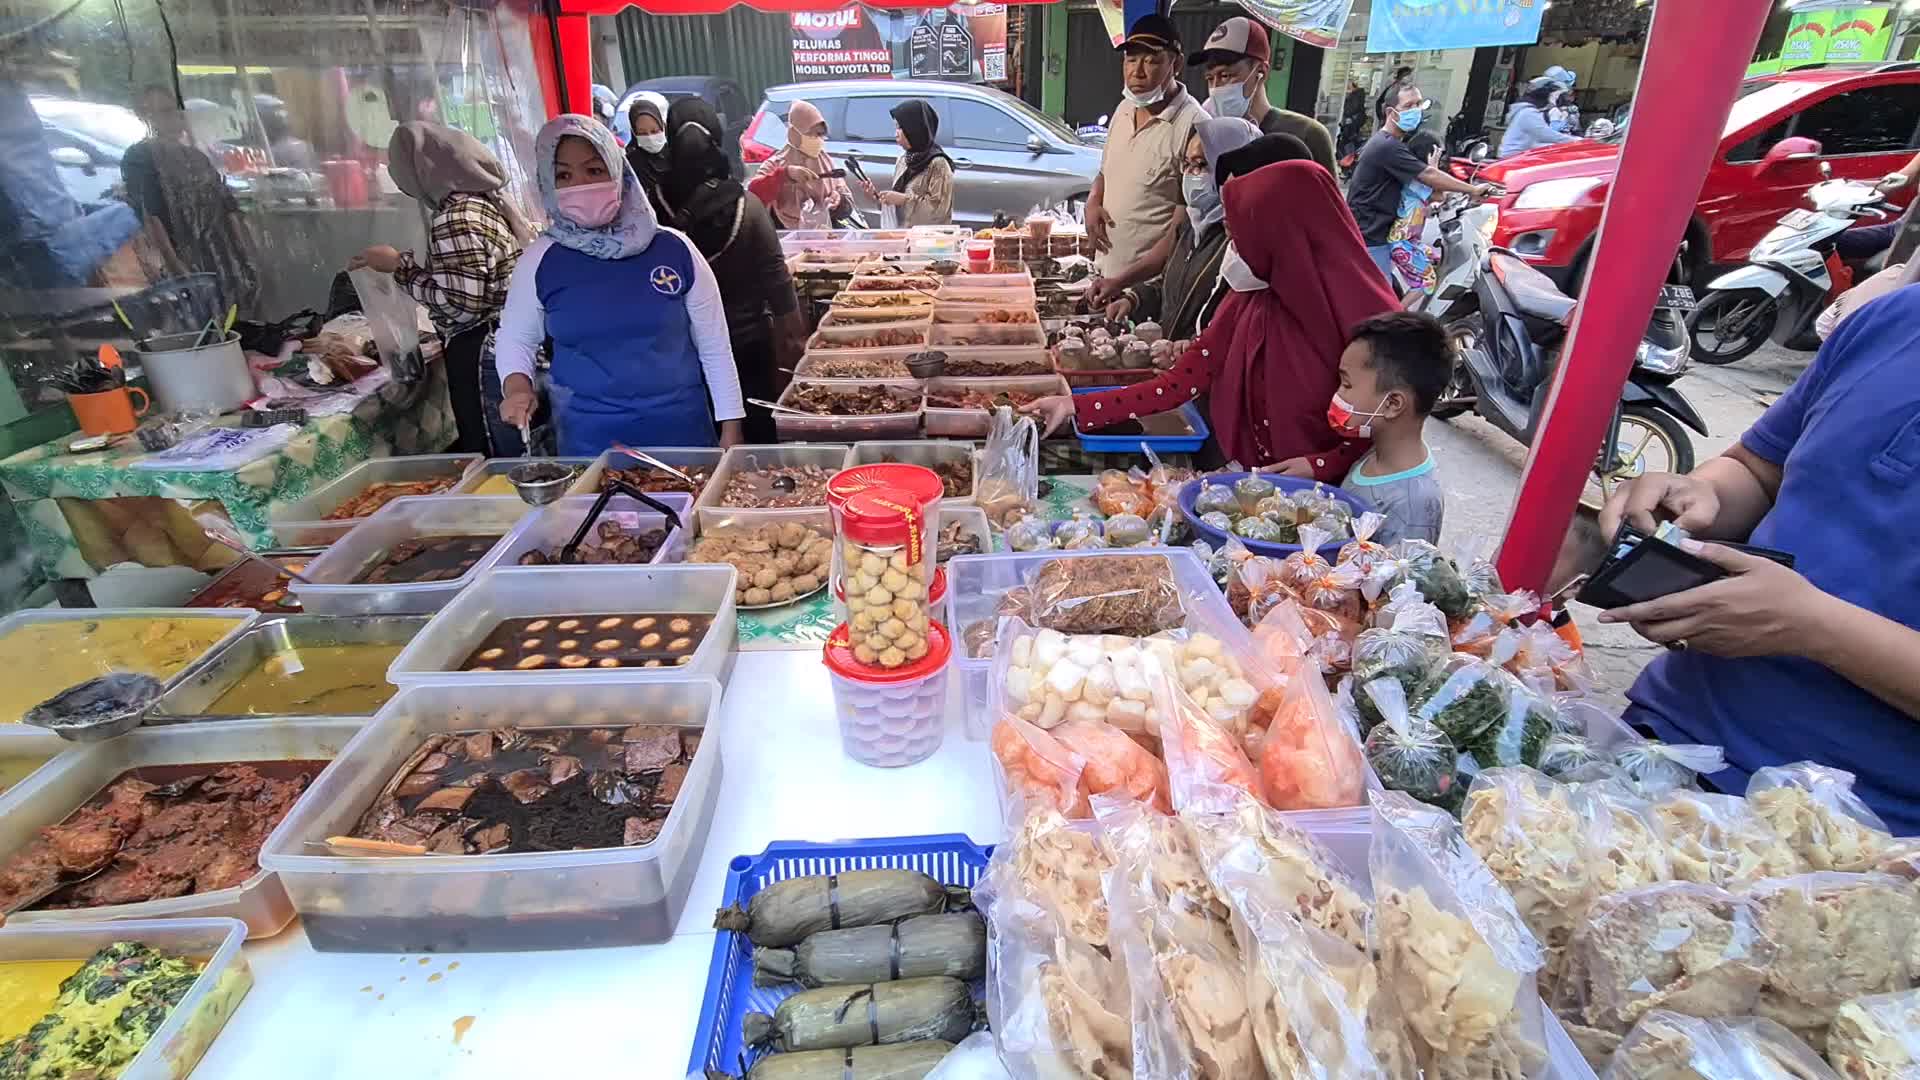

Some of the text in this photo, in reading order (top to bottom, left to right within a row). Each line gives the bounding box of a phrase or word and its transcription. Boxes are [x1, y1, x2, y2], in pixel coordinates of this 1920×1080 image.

[794, 9, 858, 28] MOTUL
[793, 40, 841, 49] PELUMAS
[794, 51, 889, 62] PERFORMA TINGGI
[796, 63, 890, 74] MOBIL TOYOTA TRD
